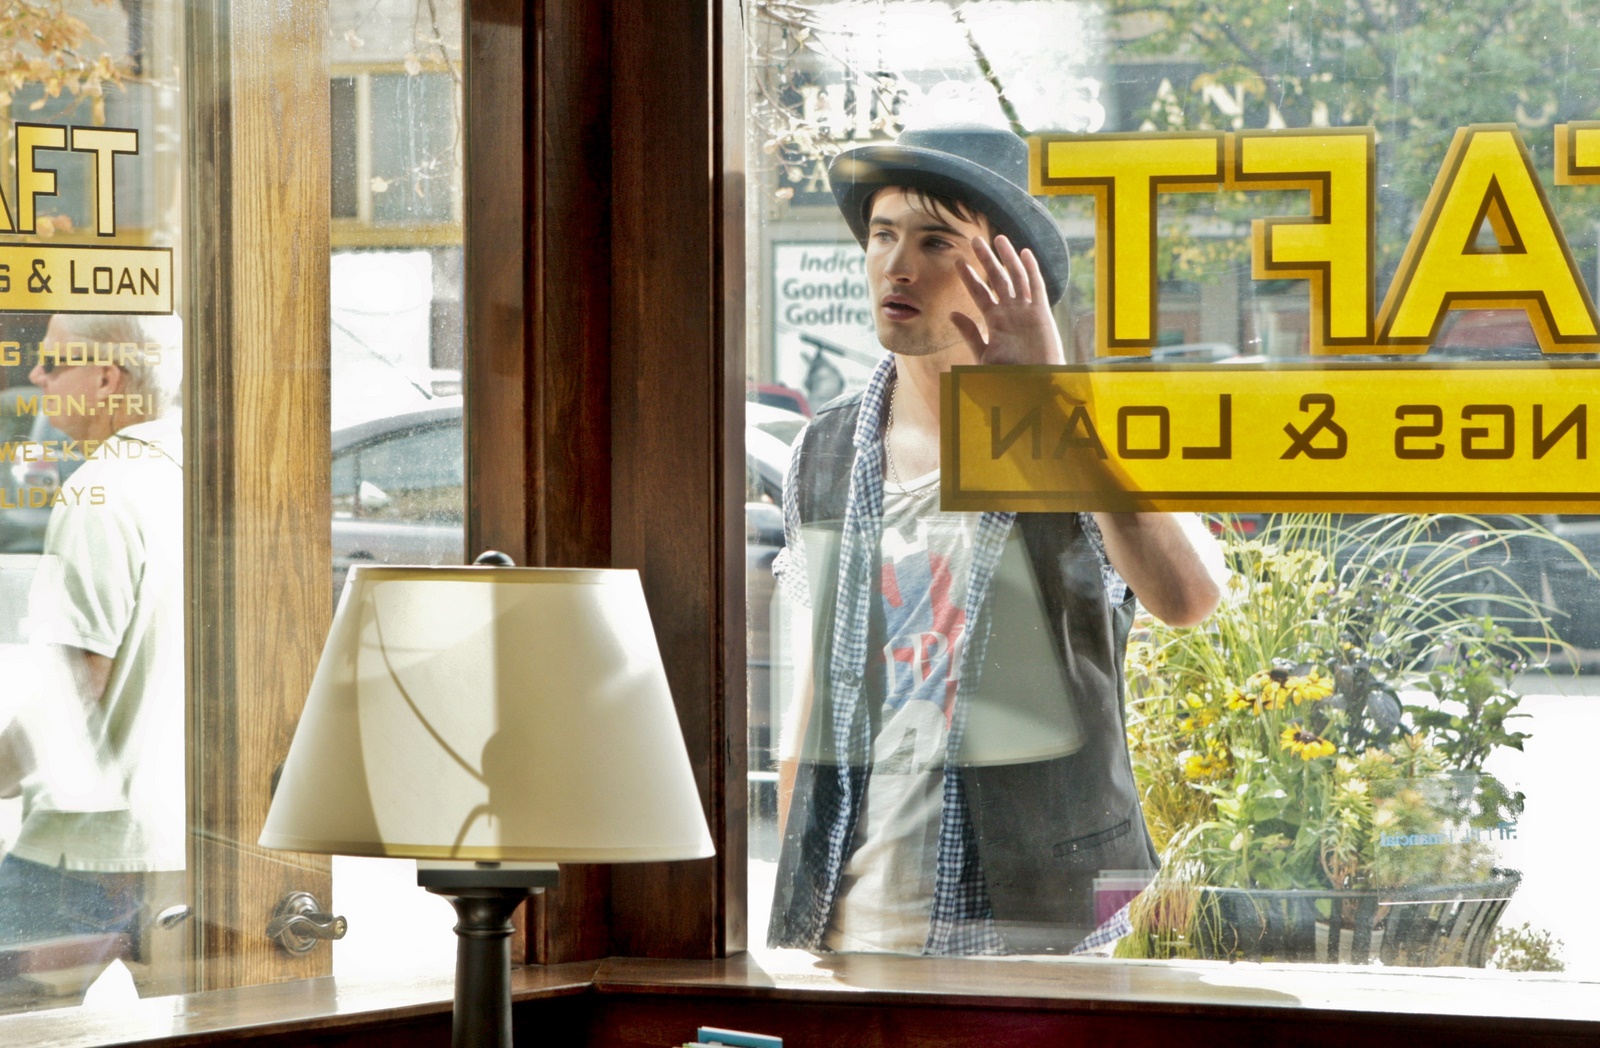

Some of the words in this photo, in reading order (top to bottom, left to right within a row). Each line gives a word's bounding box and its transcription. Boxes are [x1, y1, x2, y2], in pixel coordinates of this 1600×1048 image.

[0, 121, 139, 237] FT
[27, 258, 53, 294] &
[70, 259, 160, 295] LOAN
[38, 341, 162, 366] HOURS
[0, 440, 163, 463] WEEKENDS
